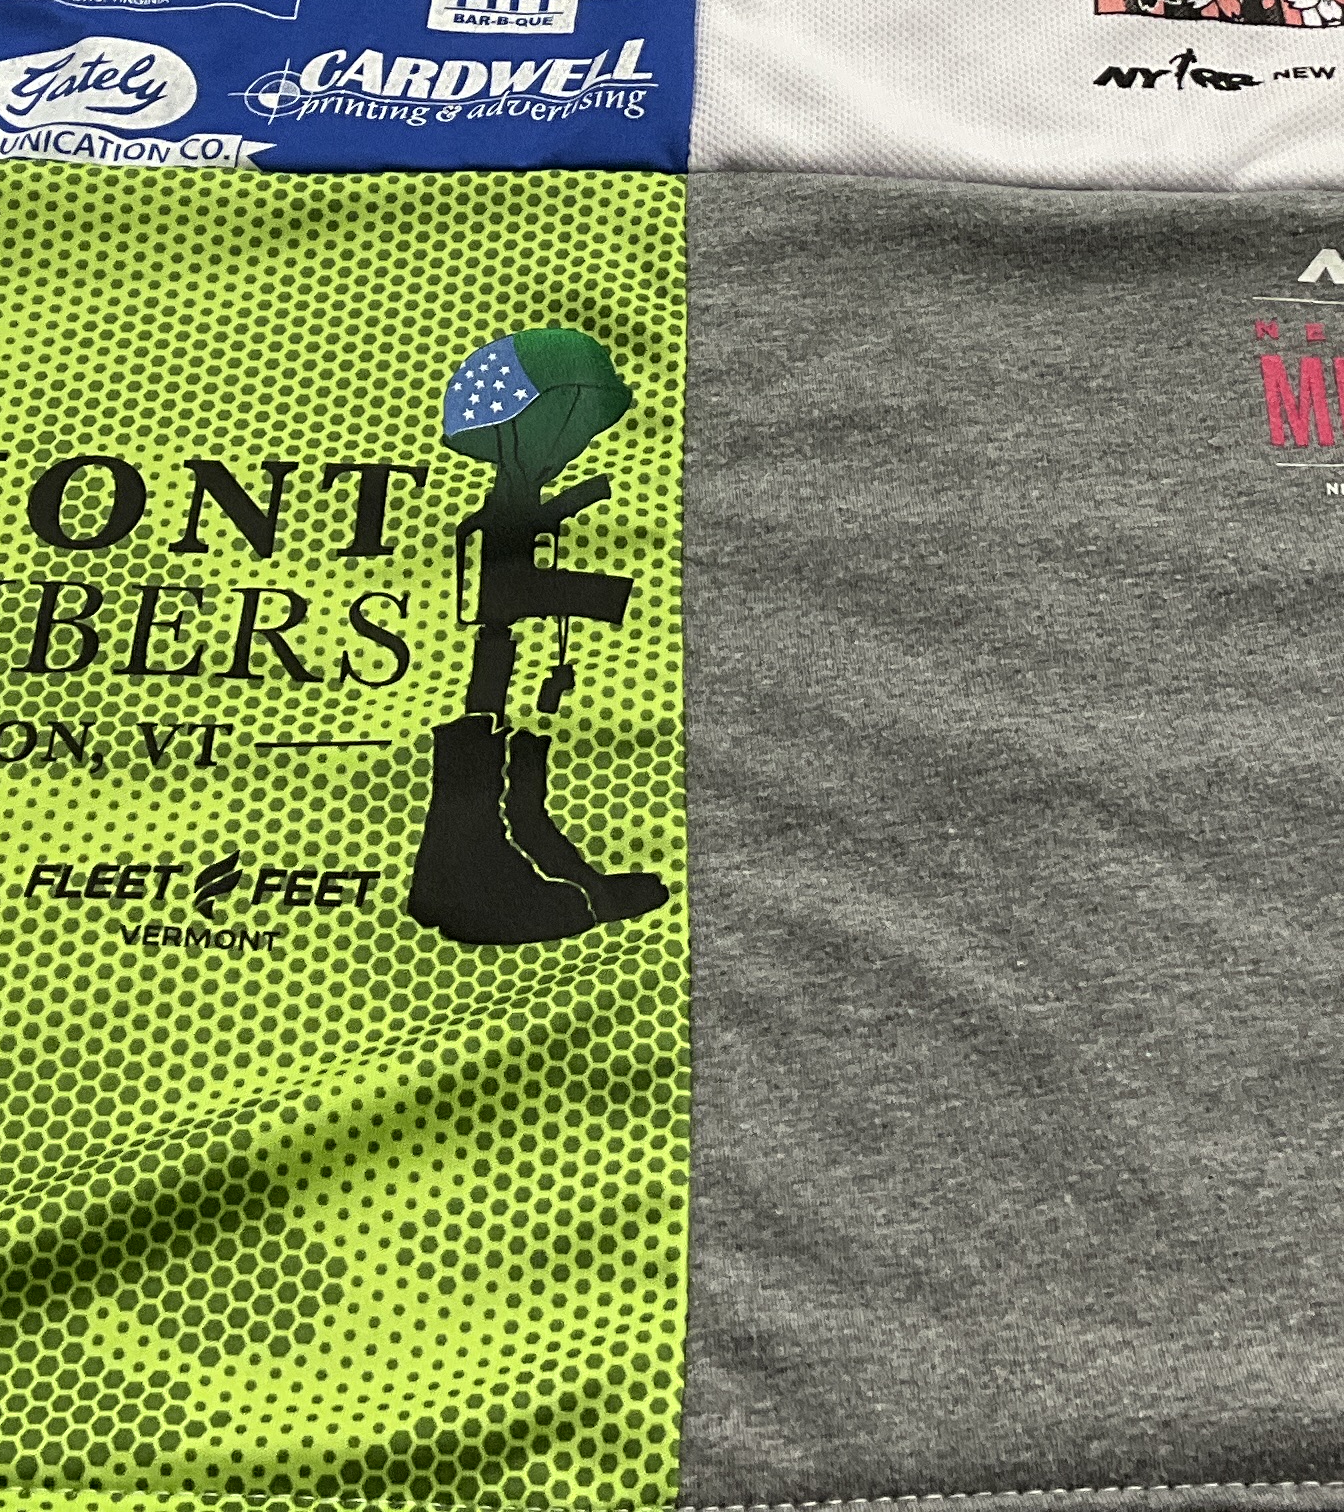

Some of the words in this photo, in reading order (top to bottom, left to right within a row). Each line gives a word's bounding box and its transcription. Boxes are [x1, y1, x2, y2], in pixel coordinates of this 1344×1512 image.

[453, 12, 554, 27] BAR-B-QUE
[6, 53, 168, 117] Gately
[299, 38, 653, 99] CARDWELL
[1273, 65, 1336, 81] NEW
[295, 94, 430, 126] printing
[434, 103, 462, 121] &
[466, 85, 649, 122] advertising
[179, 138, 230, 161] CO.
[134, 721, 236, 768] VT
[24, 864, 185, 900] FLEET
[252, 869, 381, 907] FEET
[120, 924, 282, 951] VERMONT
